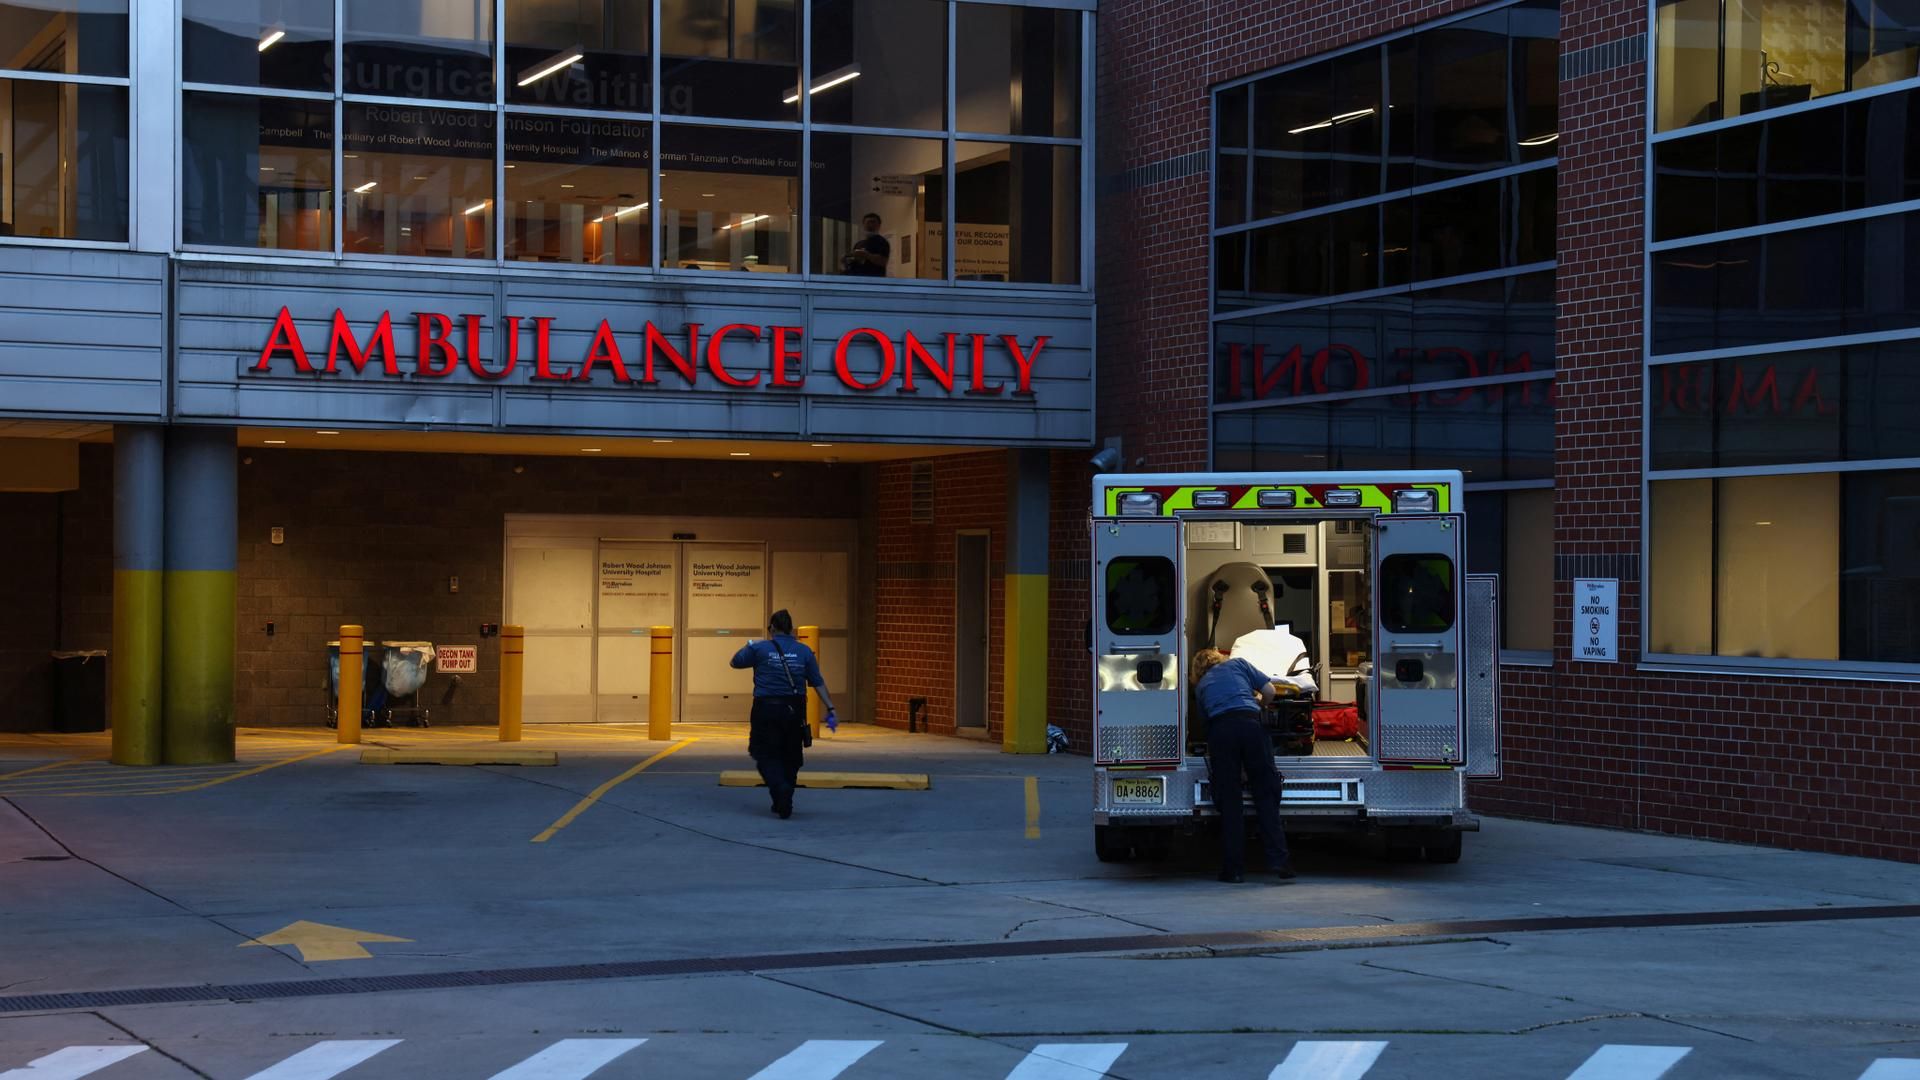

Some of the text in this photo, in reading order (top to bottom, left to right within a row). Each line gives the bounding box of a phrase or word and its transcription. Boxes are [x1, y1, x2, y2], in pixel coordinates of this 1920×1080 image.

[366, 105, 424, 124] Robert
[427, 110, 477, 128] Wood
[483, 112, 554, 133] Jhnson
[257, 125, 304, 138] Campbell
[313, 129, 332, 141] The
[341, 131, 374, 144] uxiliary
[377, 134, 387, 143] of
[389, 134, 420, 145] Robert
[423, 137, 450, 147] Wood
[453, 138, 493, 149] Johnson
[543, 144, 579, 156] Hospital
[591, 147, 607, 157] The
[642, 150, 649, 159] &
[659, 152, 686, 161] orman
[689, 153, 728, 163] Tanzman
[732, 155, 775, 167] Charitable
[928, 229, 935, 237] IN
[937, 229, 972, 238] GEFUL
[974, 239, 1003, 247] DONORS
[249, 305, 1053, 396] AMBULANCE ONLY
[693, 562, 714, 570] Robert
[602, 569, 633, 577] University
[693, 569, 750, 577] University Hospital
[1590, 596, 1600, 605] NO
[1581, 606, 1609, 615] SMOKING
[1590, 637, 1599, 646] NO
[439, 650, 474, 658] DECON TANK
[1583, 647, 1606, 657] VAPING
[442, 660, 471, 668] PUMP OUT
